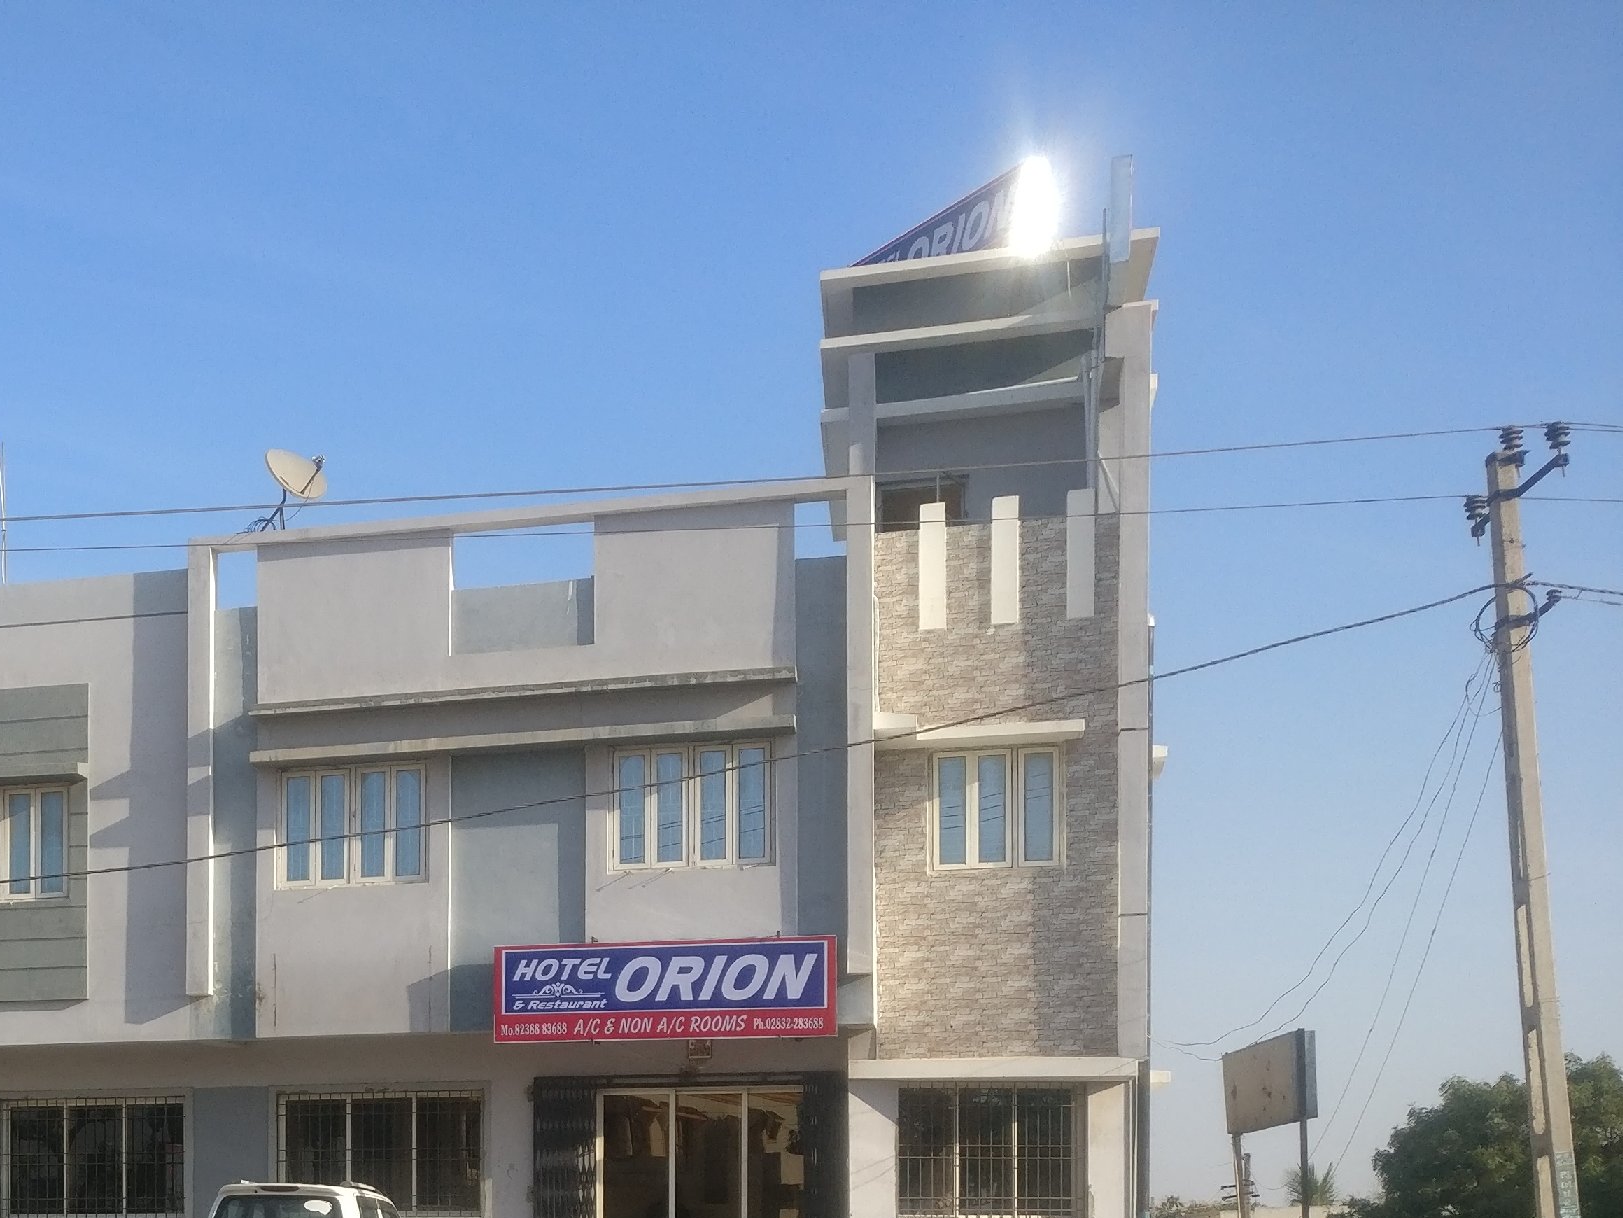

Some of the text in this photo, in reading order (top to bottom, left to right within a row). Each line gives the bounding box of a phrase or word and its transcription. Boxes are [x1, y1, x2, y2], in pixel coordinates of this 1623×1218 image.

[512, 953, 818, 1003] HOTEL ORION
[513, 998, 608, 1010] & Restaurant
[573, 1018, 601, 1036] A/C
[604, 1017, 615, 1035] &
[618, 1017, 653, 1034] NON
[656, 1016, 686, 1035] A/C
[689, 1014, 748, 1032] ROOMS
